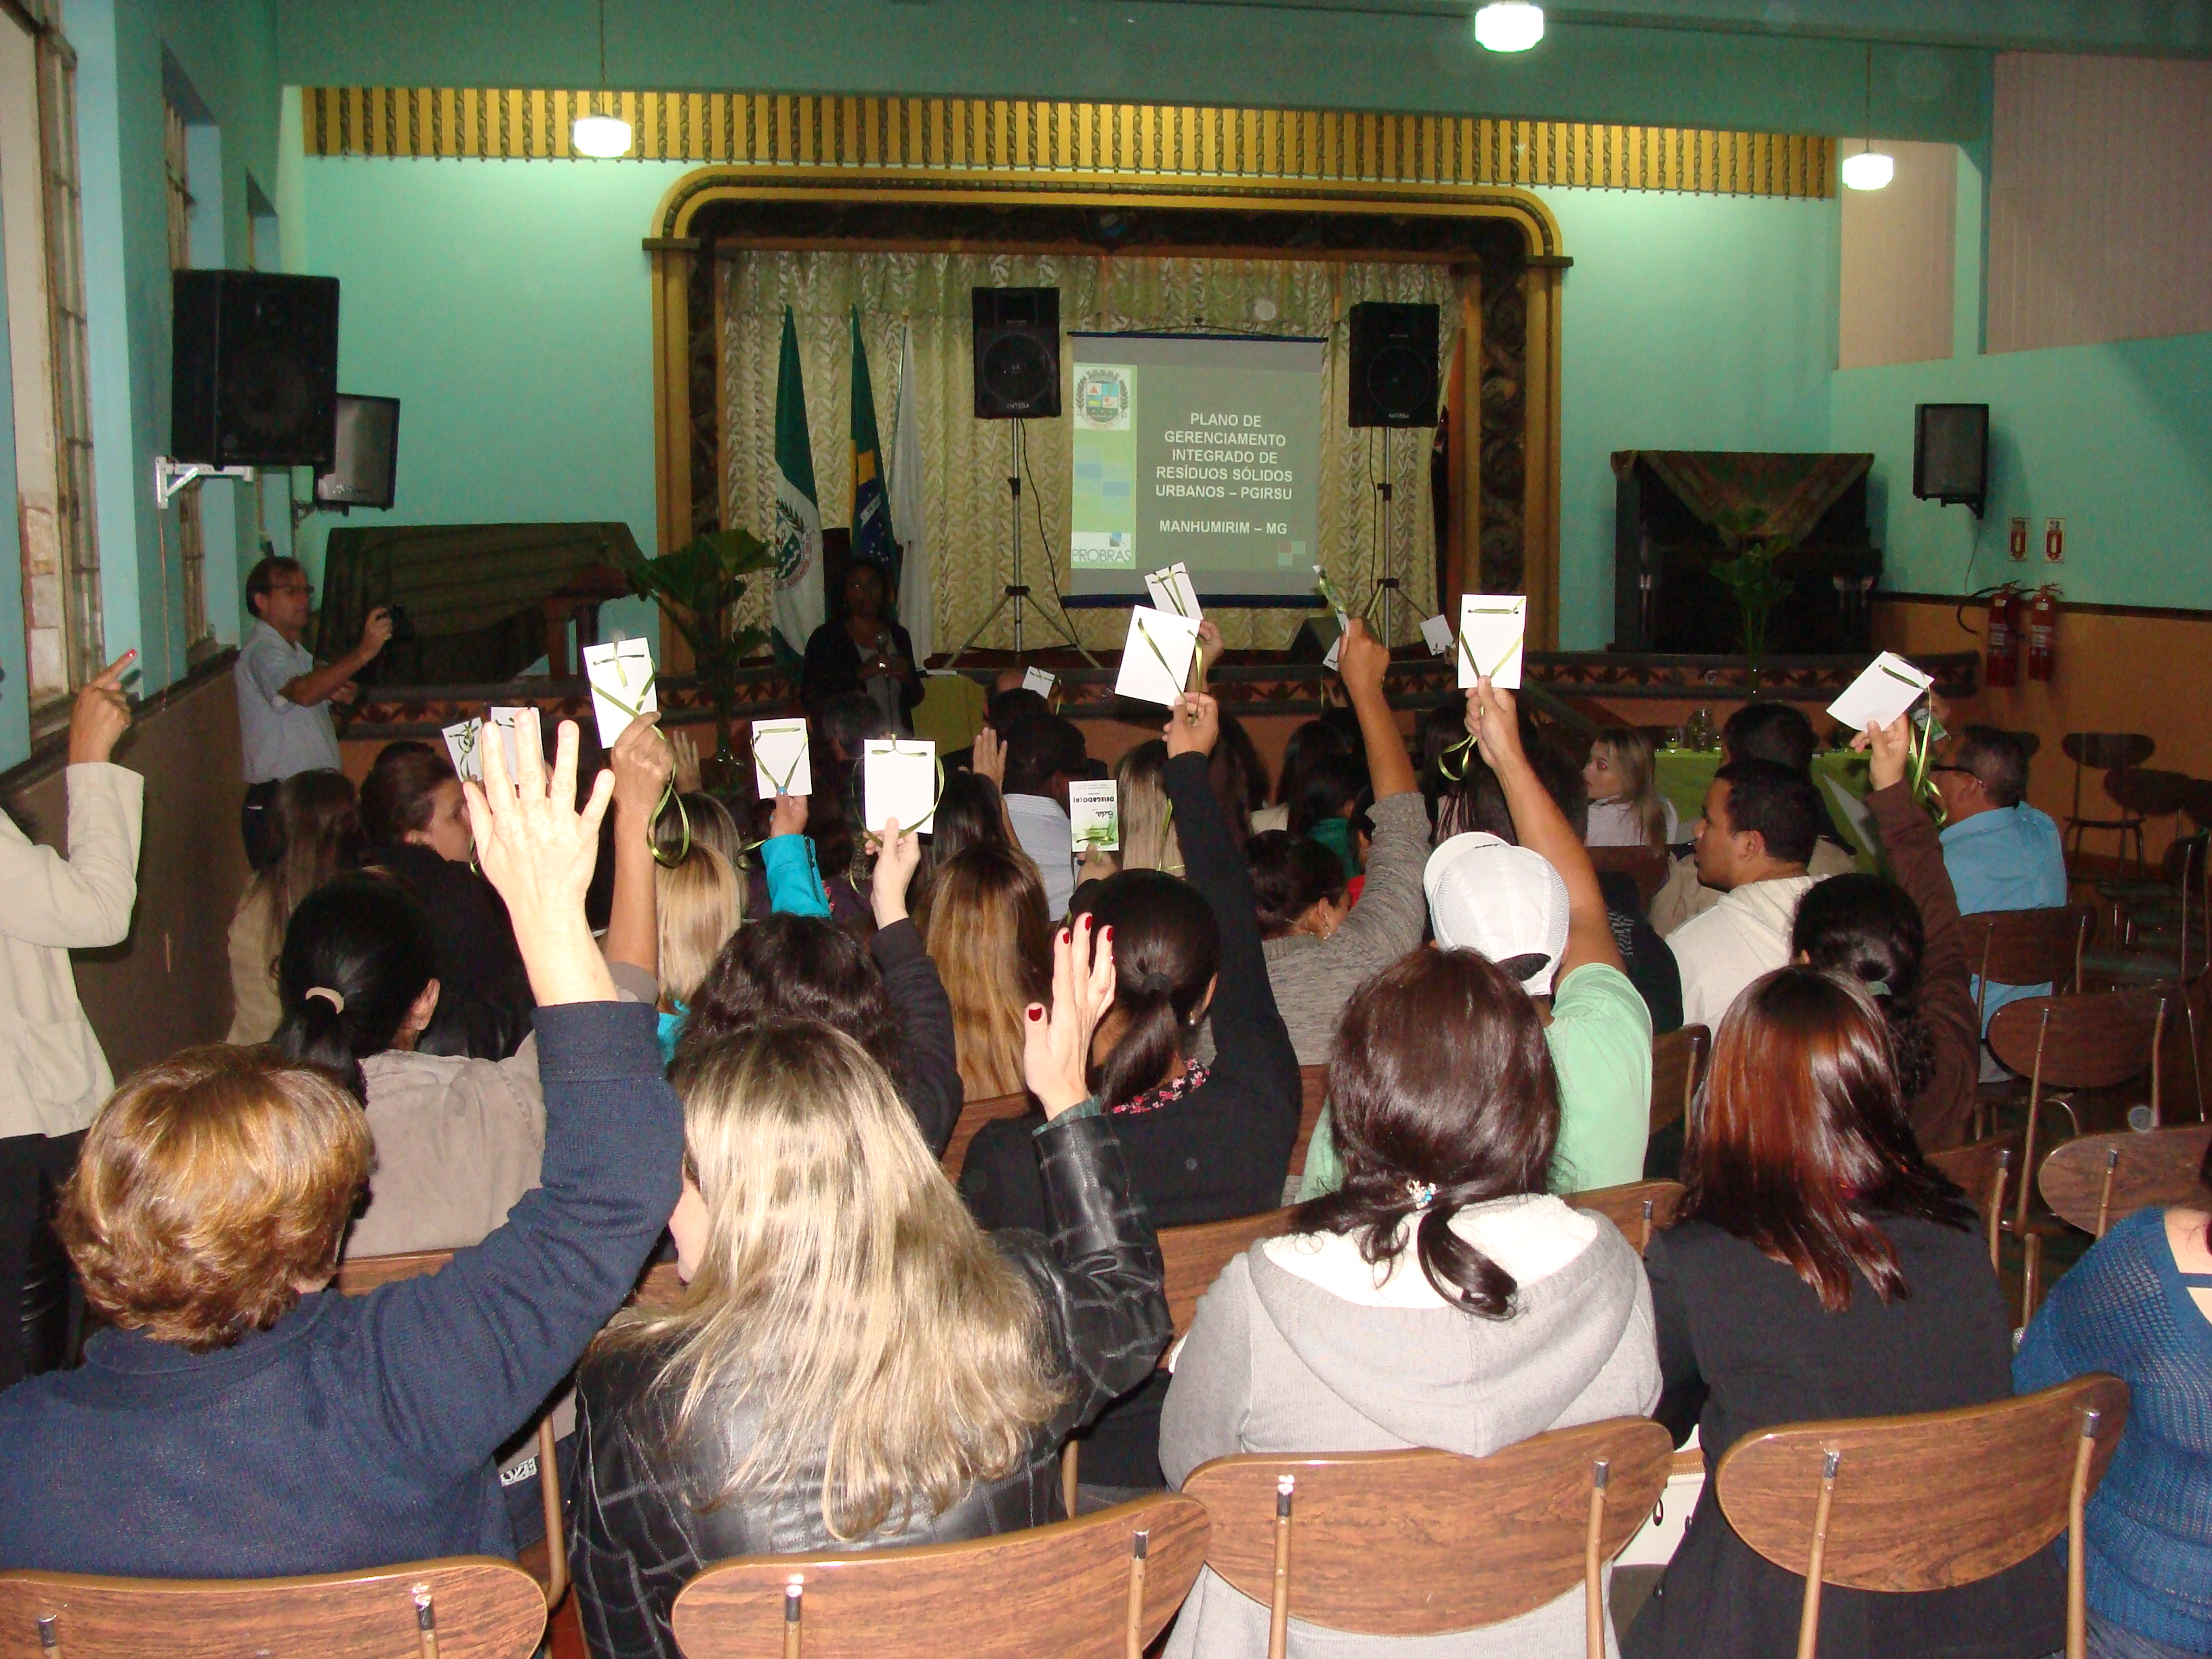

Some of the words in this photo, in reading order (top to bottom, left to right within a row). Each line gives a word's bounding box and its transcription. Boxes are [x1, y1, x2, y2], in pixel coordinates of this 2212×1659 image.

[1190, 412, 1238, 426] PLANO
[1243, 415, 1262, 428] DE
[1164, 430, 1286, 447] GERENCIAMENTO
[1172, 449, 1254, 464] INTEGRADO
[1259, 451, 1278, 464] DE
[1156, 465, 1228, 480] RESÍDUOS
[1232, 466, 1293, 483] SÓLIDOS
[1155, 484, 1225, 498] URBANOS
[1241, 486, 1292, 500] PGIRSU
[1159, 520, 1250, 534] MANHUMIRIM
[1266, 523, 1288, 535] MG
[1072, 548, 1132, 562] PROBRAS
